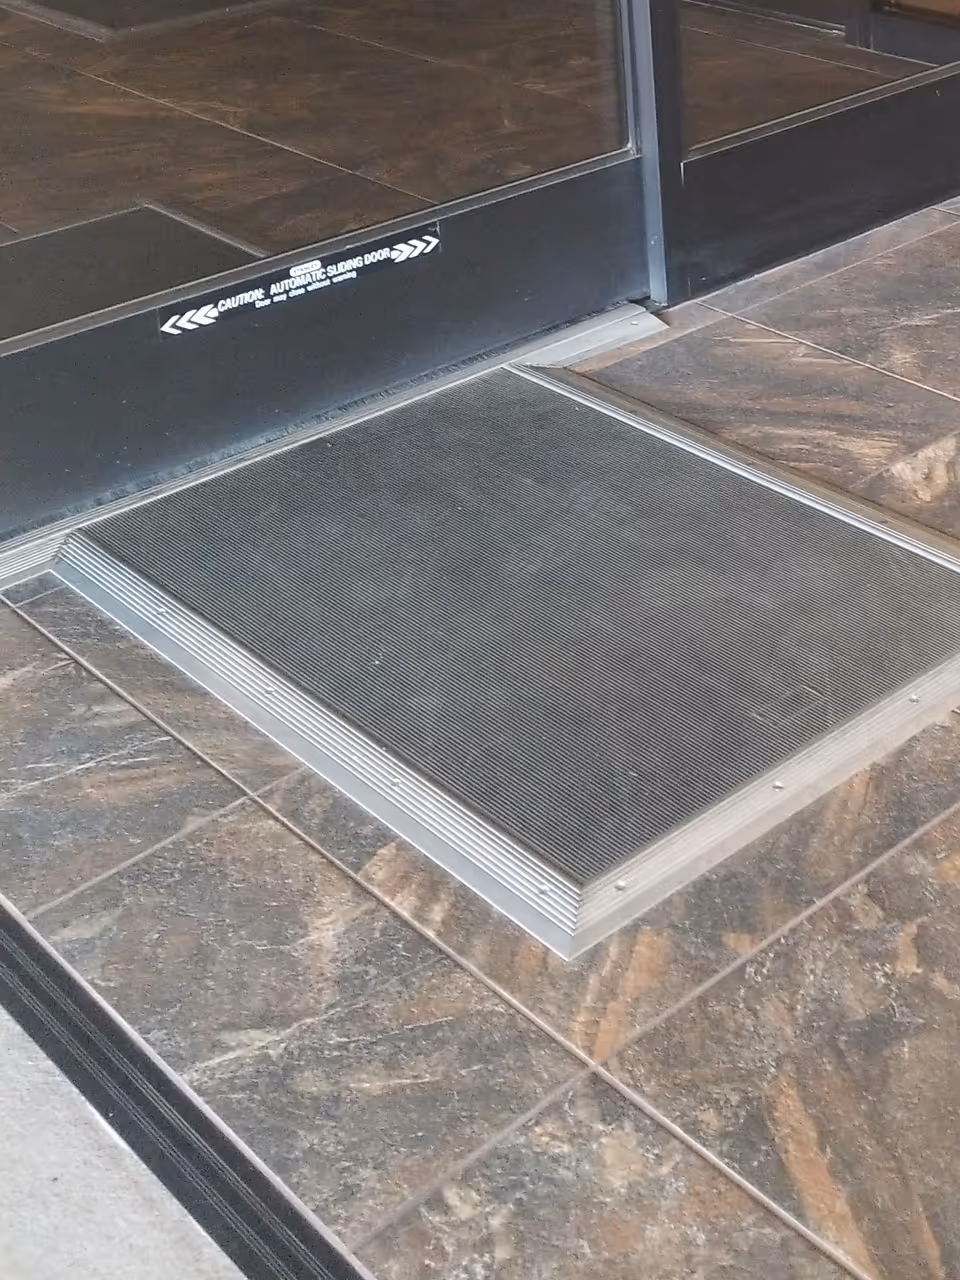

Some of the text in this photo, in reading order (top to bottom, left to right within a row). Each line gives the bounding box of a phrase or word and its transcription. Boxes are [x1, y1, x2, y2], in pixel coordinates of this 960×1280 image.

[217, 247, 391, 313] CAUTION: AUTOMATIC SLIDING DOOR
[254, 298, 272, 309] Door
